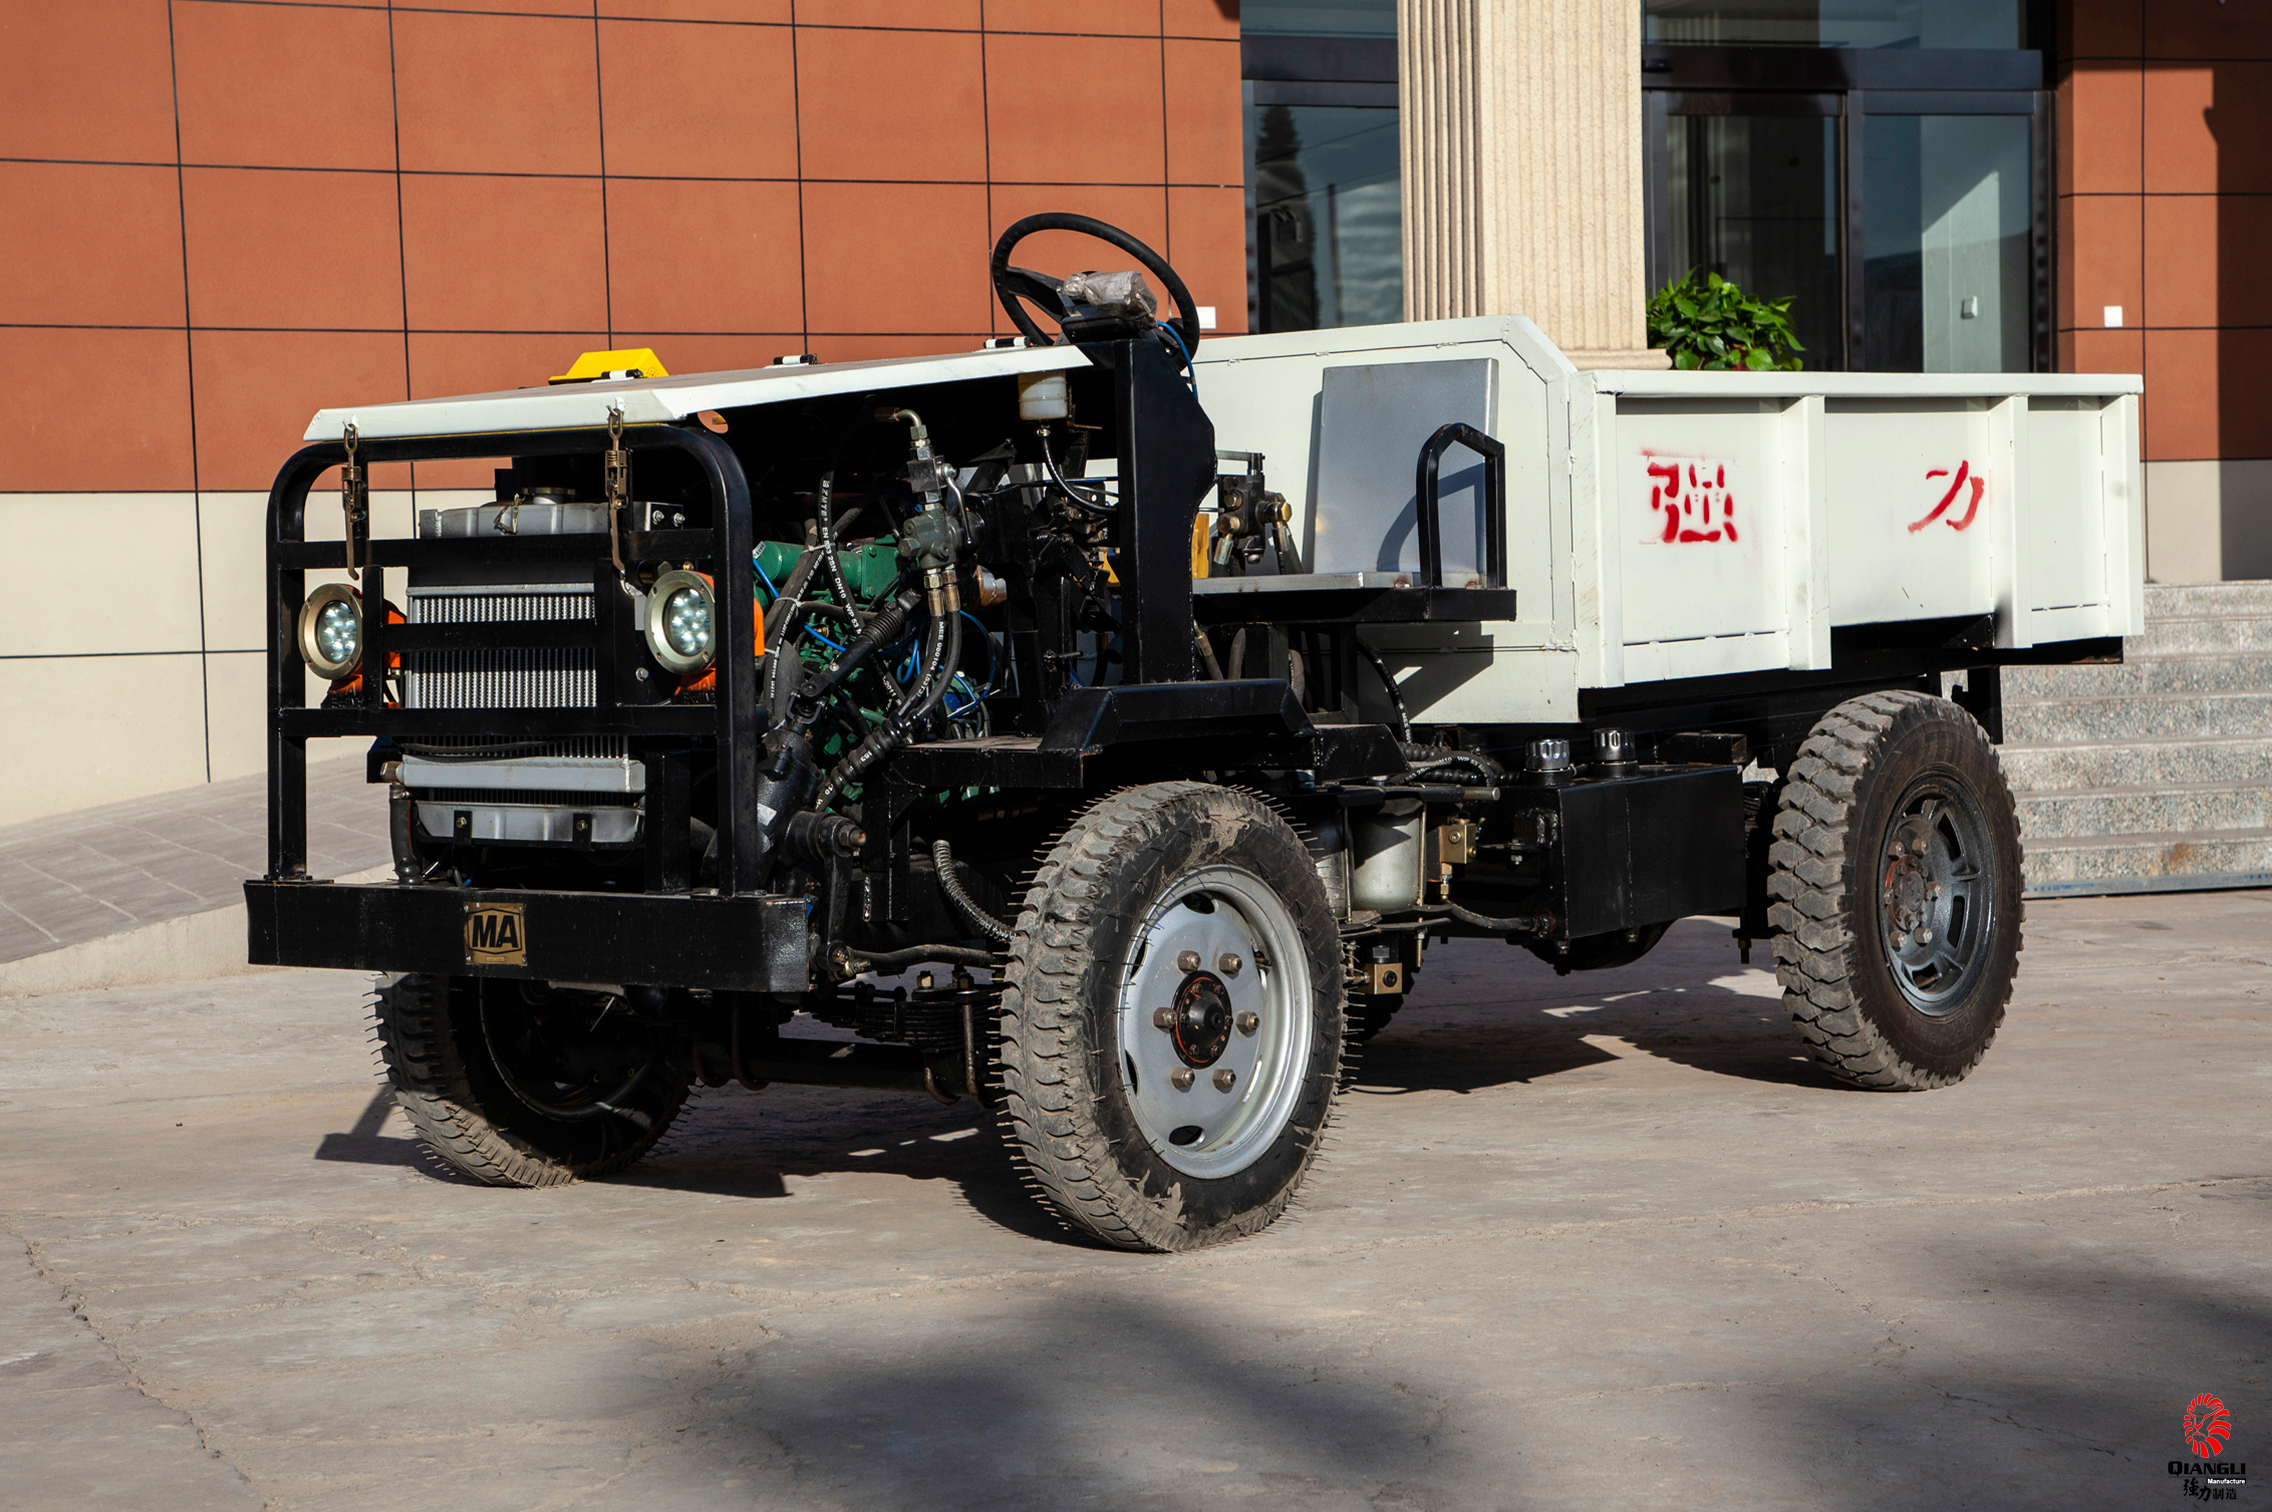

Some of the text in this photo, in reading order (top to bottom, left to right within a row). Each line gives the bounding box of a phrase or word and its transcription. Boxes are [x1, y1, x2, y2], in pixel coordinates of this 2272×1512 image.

[834, 577, 847, 599] DN10
[845, 602, 855, 618] WP
[471, 914, 519, 949] MA
